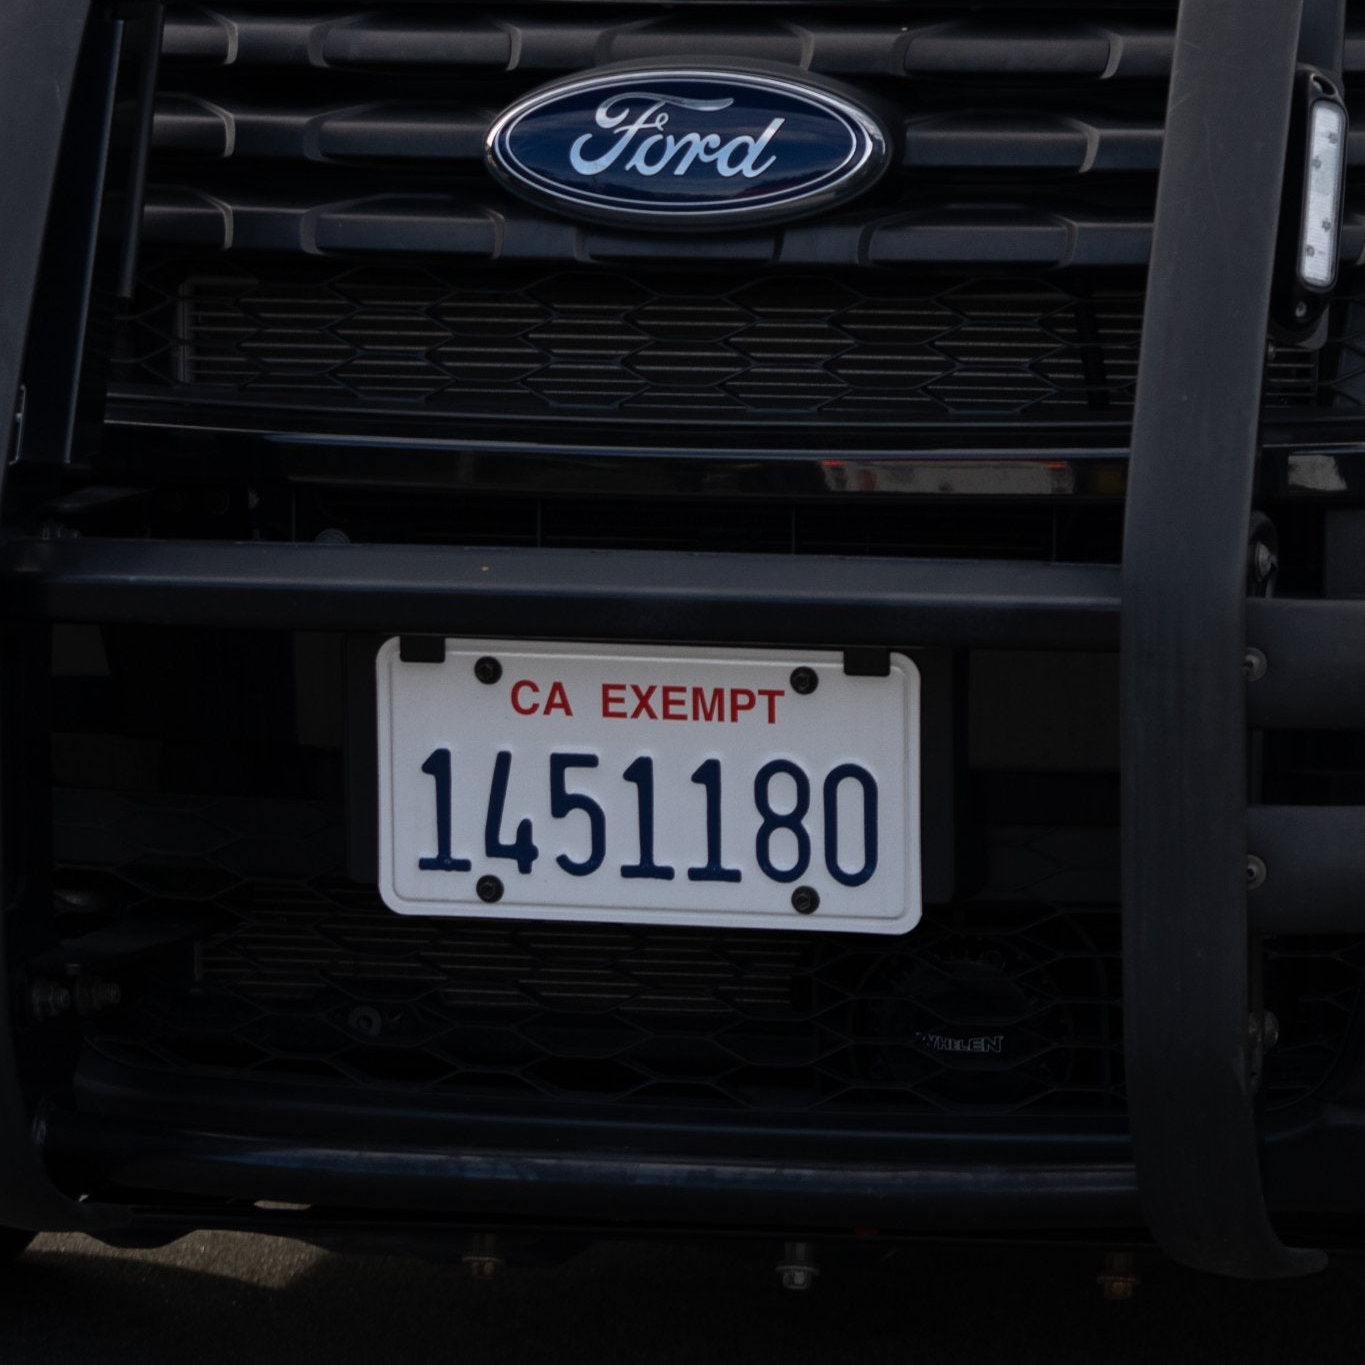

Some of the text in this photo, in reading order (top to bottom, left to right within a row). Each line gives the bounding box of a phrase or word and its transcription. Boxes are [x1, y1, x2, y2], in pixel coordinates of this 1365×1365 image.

[569, 91, 786, 179] Ford
[510, 679, 786, 725] CA EXEMPT
[418, 747, 879, 888] 1451180
